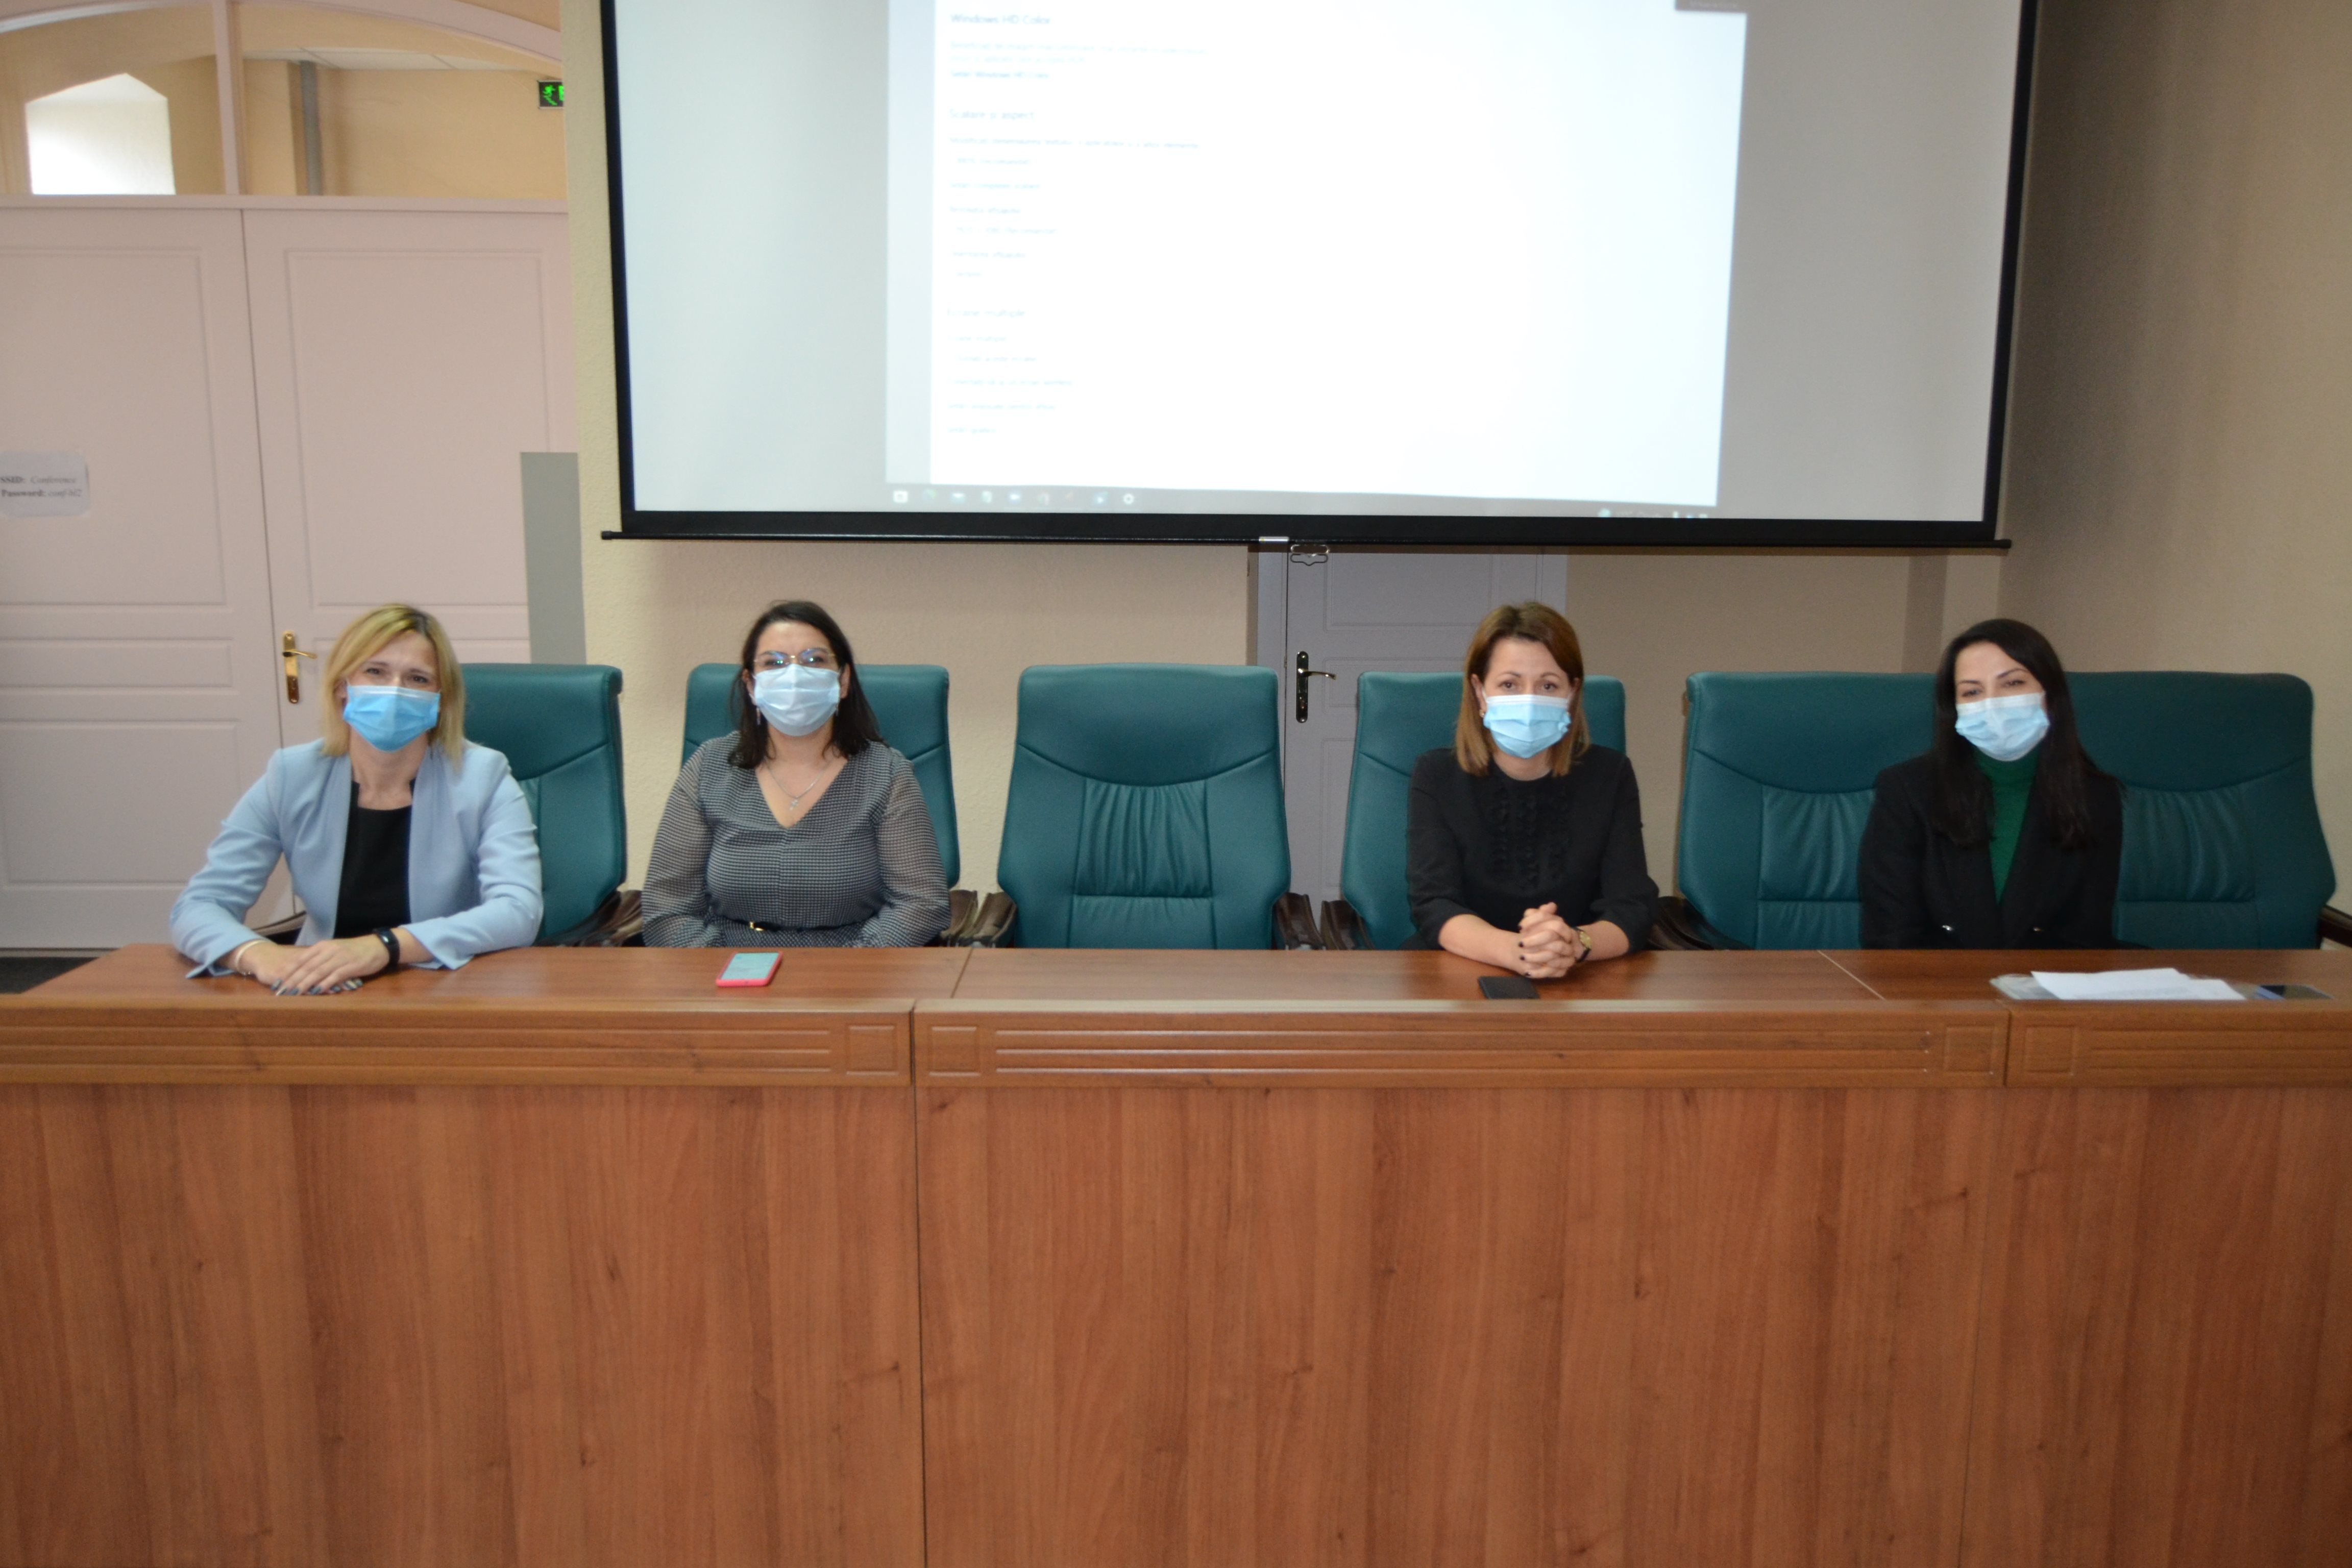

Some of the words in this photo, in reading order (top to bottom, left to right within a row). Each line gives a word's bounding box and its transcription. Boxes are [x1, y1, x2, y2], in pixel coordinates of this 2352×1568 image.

[950, 14, 999, 24] Windows
[1001, 14, 1020, 25] HD
[1022, 14, 1051, 25] Color
